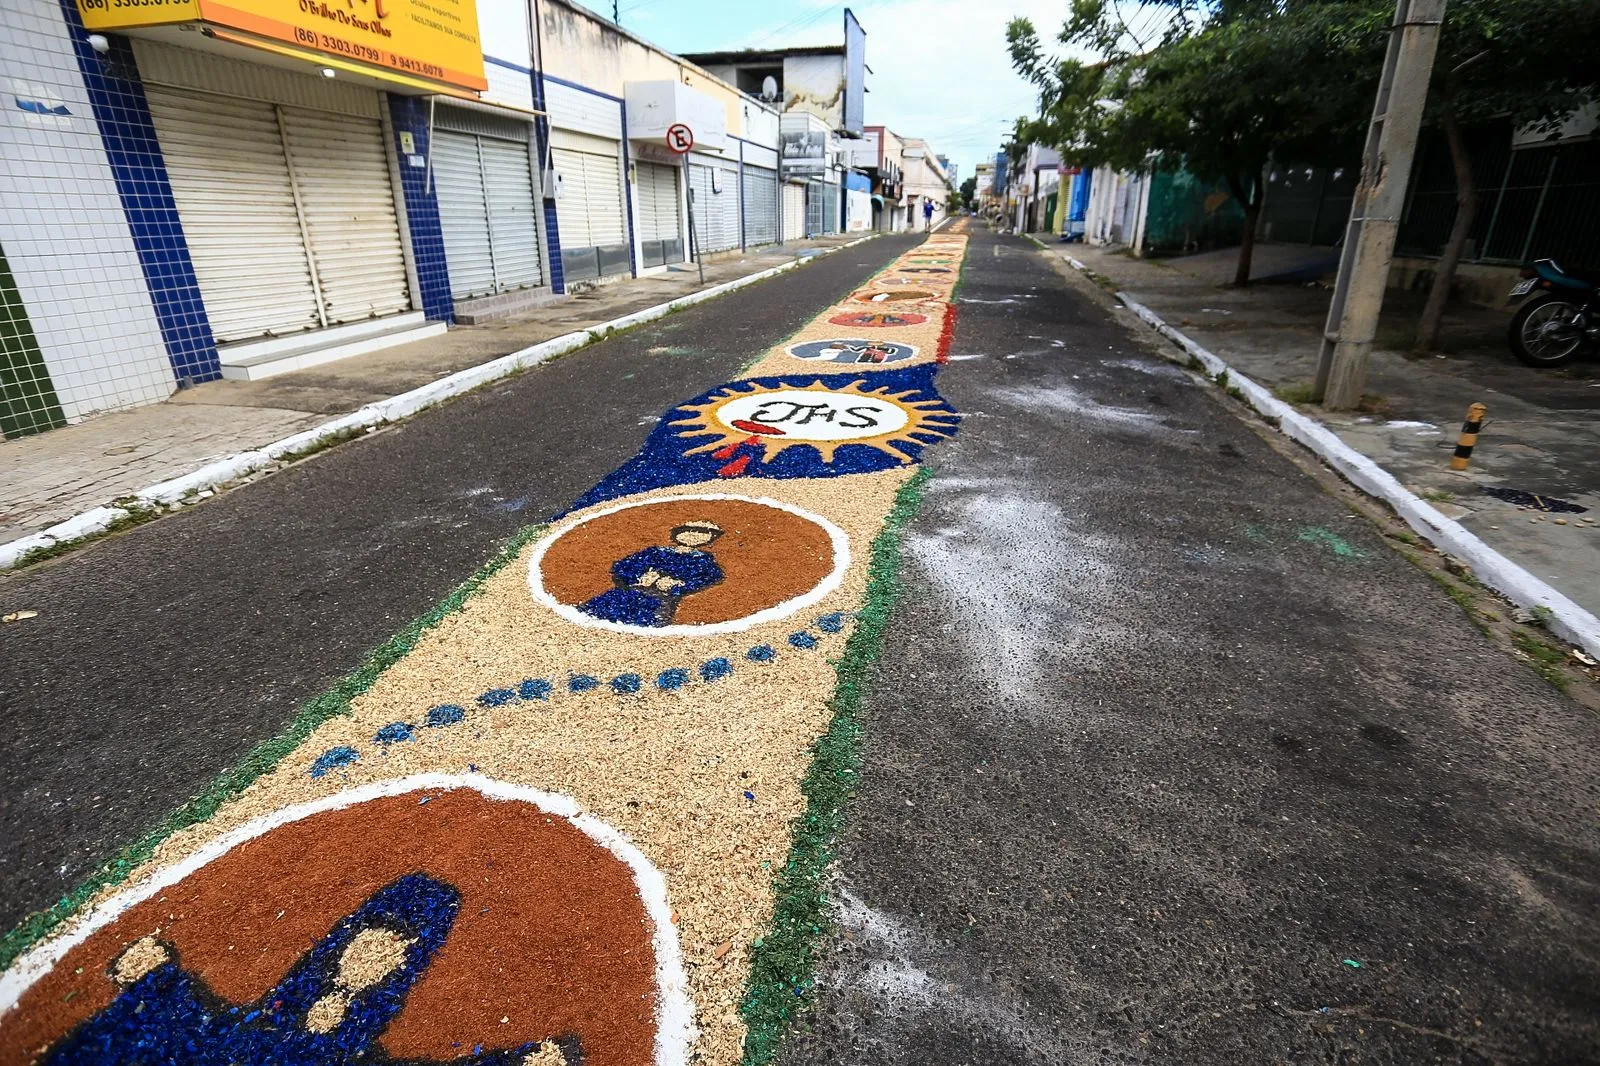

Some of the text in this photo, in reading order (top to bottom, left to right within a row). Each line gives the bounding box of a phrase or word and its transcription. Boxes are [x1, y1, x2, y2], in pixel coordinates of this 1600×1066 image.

[294, 26, 444, 78] (86) 3303.0799 9 9413.6078
[675, 129, 689, 148] E
